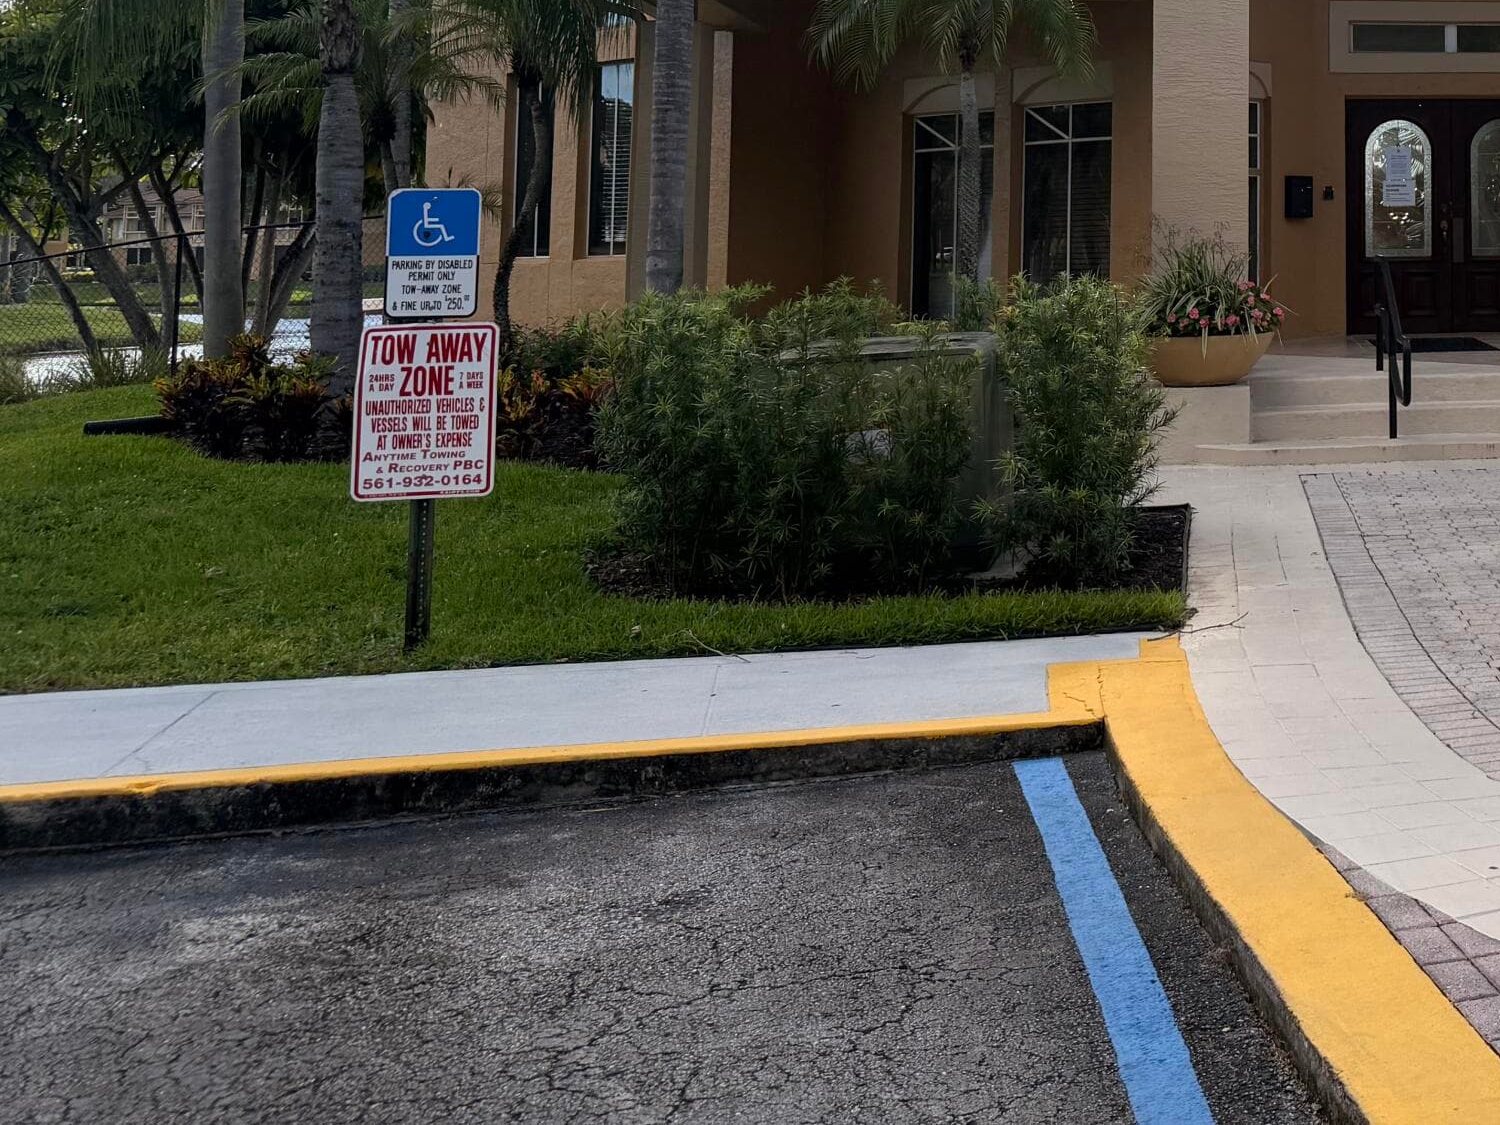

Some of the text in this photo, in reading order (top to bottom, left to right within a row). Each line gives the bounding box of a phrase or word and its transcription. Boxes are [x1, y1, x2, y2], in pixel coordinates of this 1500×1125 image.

[392, 260, 473, 270] PARKING BY DISABLED
[408, 271, 455, 281] PERMIT ONLY
[402, 285, 462, 294] TOW-AWAY ZONE
[392, 302, 397, 311] &
[401, 301, 417, 310] FINE
[371, 332, 487, 365] TOW AWAY
[369, 374, 395, 383] 24HRS
[399, 366, 454, 397] ZONE
[466, 372, 484, 380] DAYS
[369, 383, 394, 392] A DAY
[365, 397, 485, 416] UNAUTHORIZED VEHICLES &
[371, 414, 479, 433] VESSELS WILL BE TOWED
[376, 432, 472, 451] AT OWNER'S EXPENSE
[362, 449, 466, 462] ANYTIME TOWING
[388, 463, 449, 473] RECOVERY
[453, 460, 484, 470] PBC
[362, 474, 482, 490] 561-932-0164
